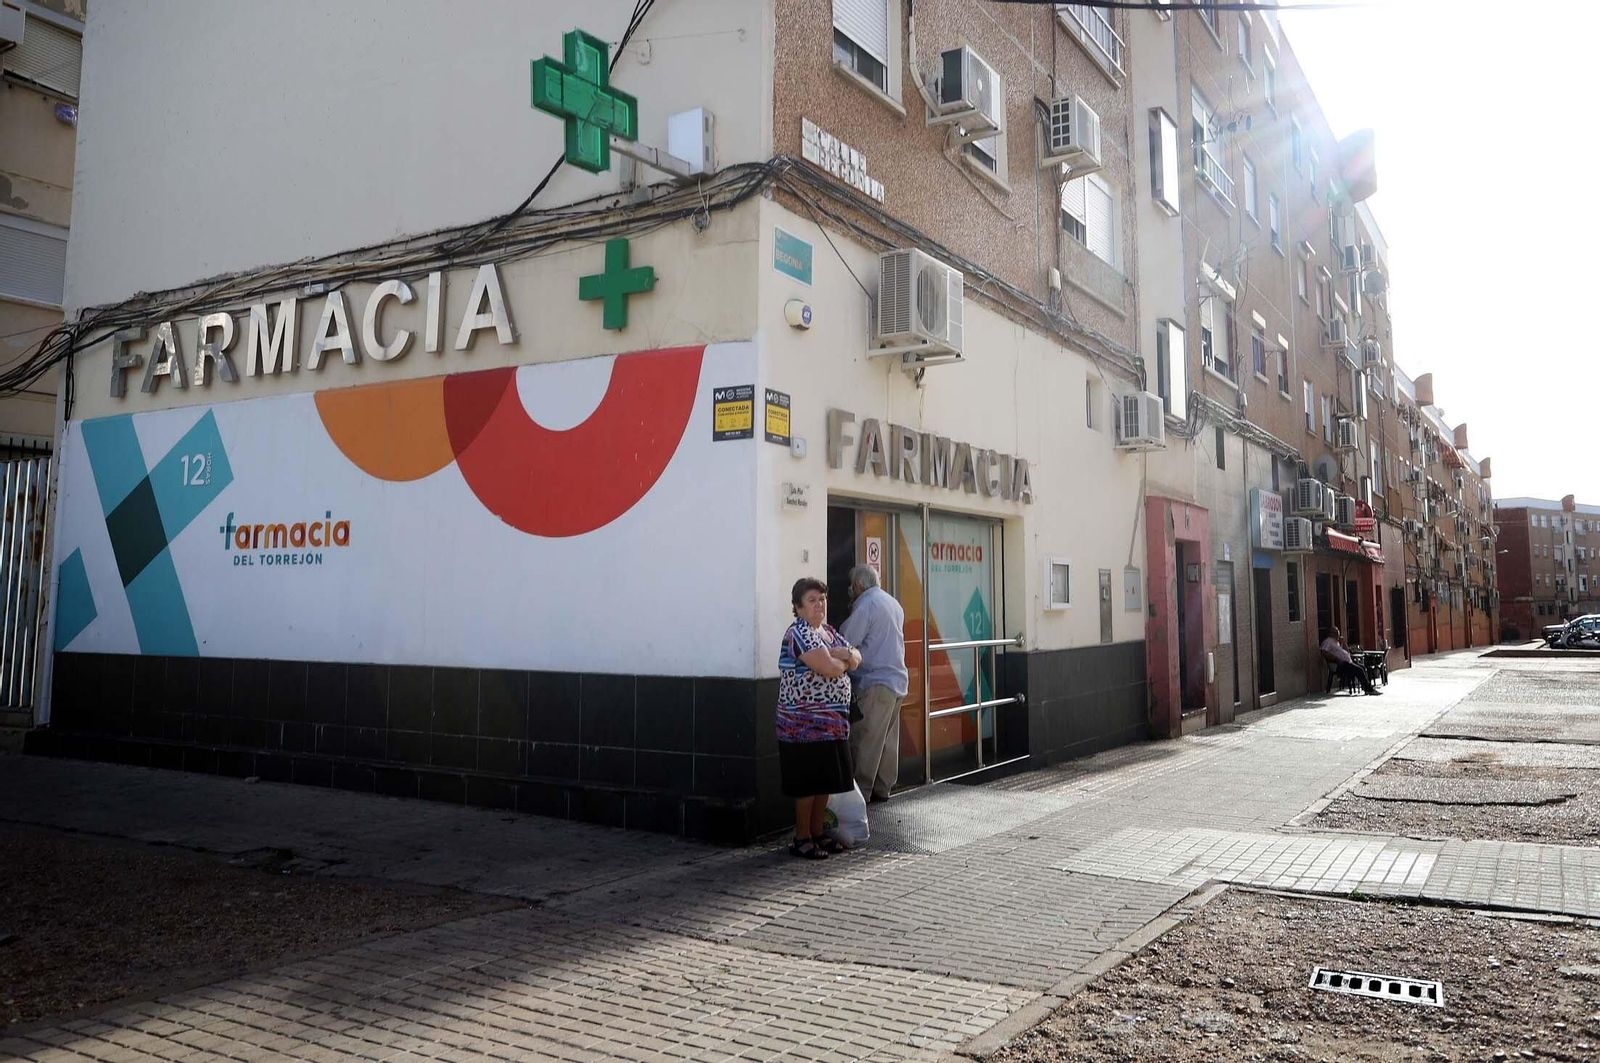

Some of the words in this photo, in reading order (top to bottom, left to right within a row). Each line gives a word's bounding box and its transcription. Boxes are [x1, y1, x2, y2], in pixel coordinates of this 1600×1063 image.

[775, 250, 803, 271] BEGONIA
[109, 262, 519, 398] FARMACIA
[827, 407, 1034, 505] FARMACIA
[181, 453, 206, 487] 12
[219, 510, 351, 550] farmacia
[233, 554, 254, 566] DEL
[260, 551, 323, 566] TORREJÓN
[928, 538, 983, 563] armacia
[931, 563, 941, 573] DEL
[969, 610, 982, 636] 12
